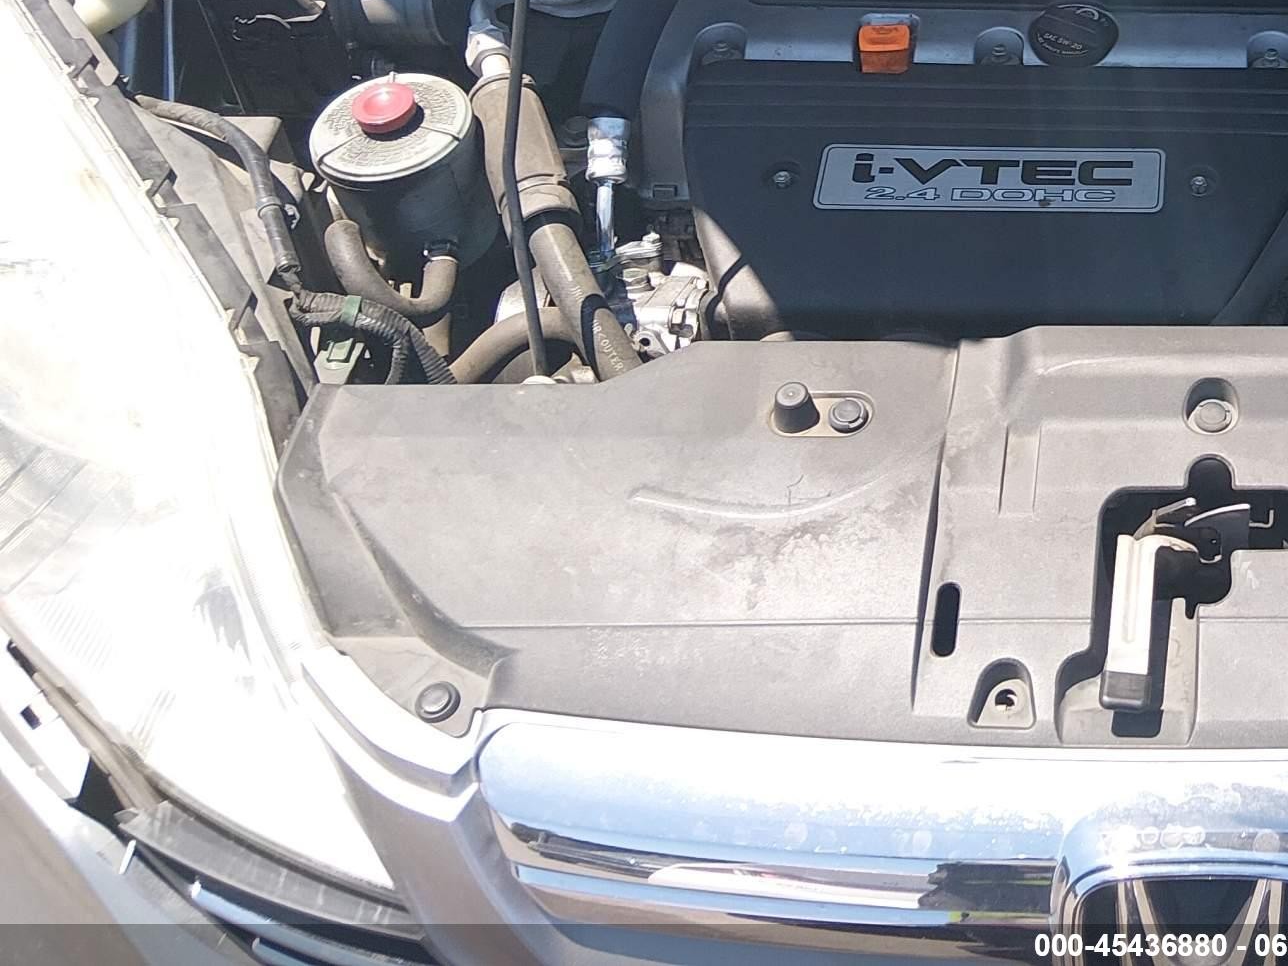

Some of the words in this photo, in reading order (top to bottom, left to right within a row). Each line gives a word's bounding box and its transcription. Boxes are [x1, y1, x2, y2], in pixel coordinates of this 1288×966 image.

[852, 153, 1134, 186] i-VTEC
[864, 186, 940, 201] 2.4
[950, 187, 1116, 203] DOHC
